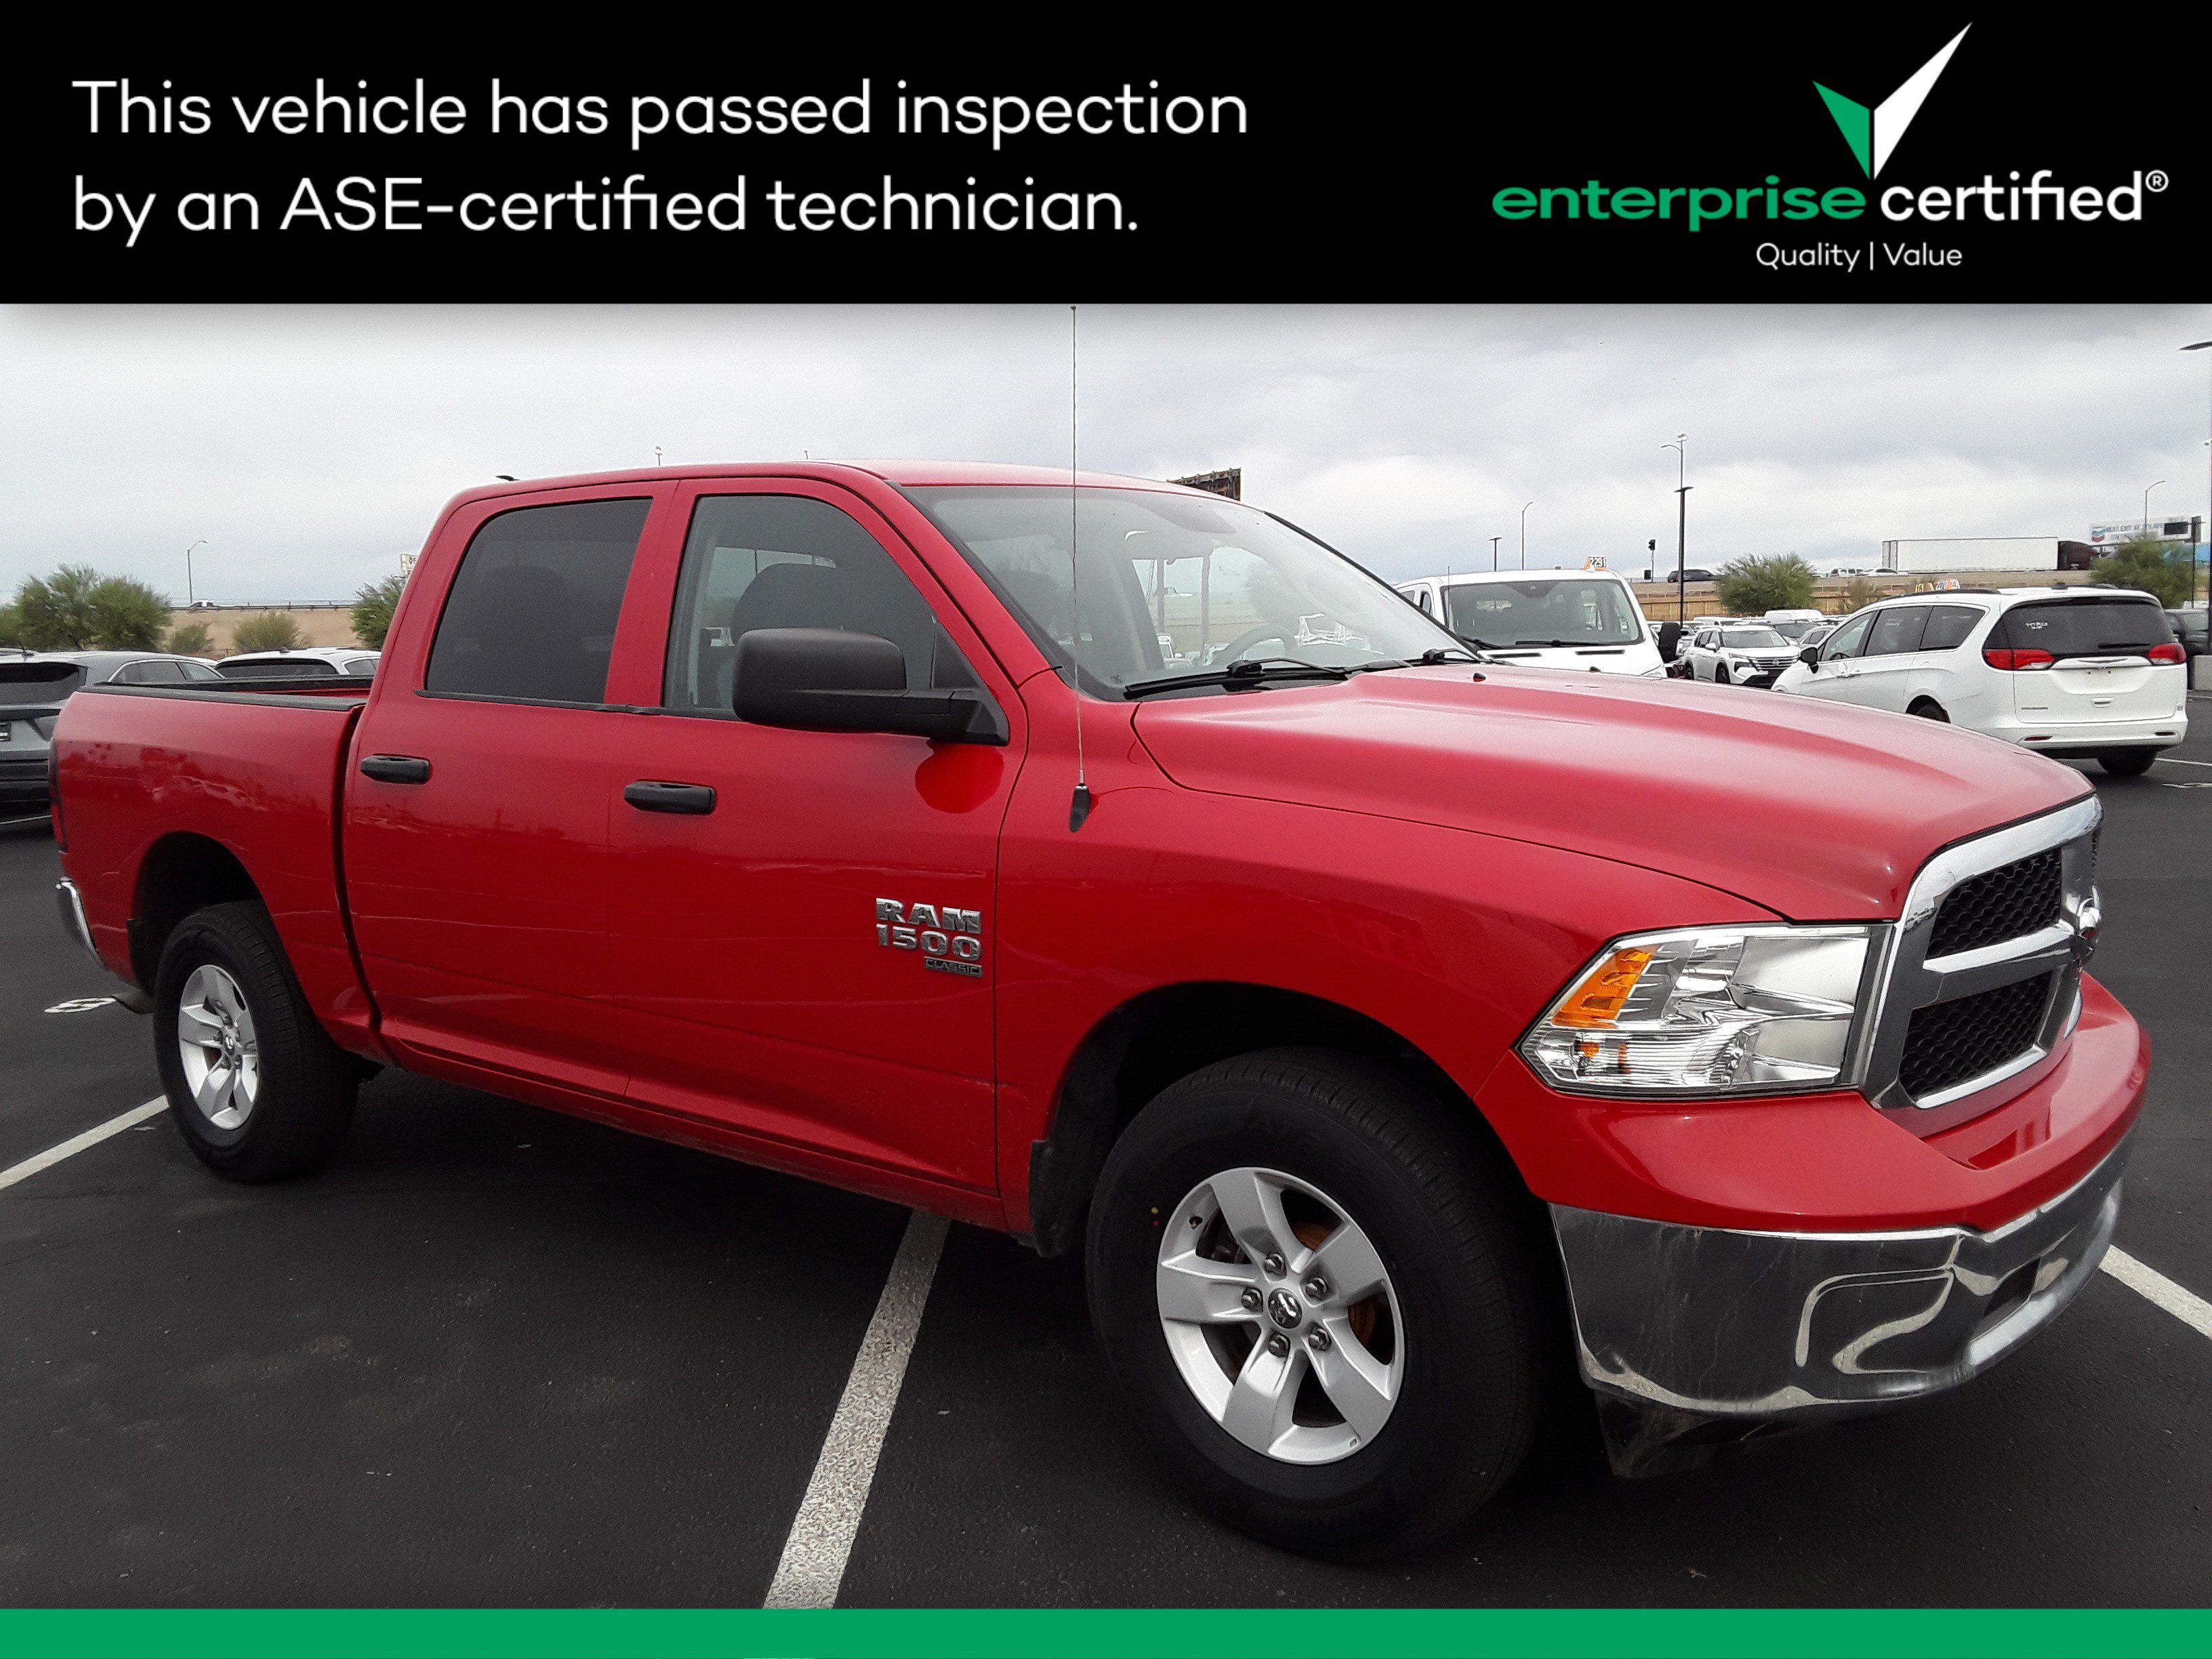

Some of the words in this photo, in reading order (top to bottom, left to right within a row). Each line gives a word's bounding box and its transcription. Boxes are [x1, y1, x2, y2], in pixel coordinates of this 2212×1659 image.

[876, 897, 982, 935] RAM
[876, 924, 983, 961] 1500
[925, 957, 982, 976] CLASSIC
